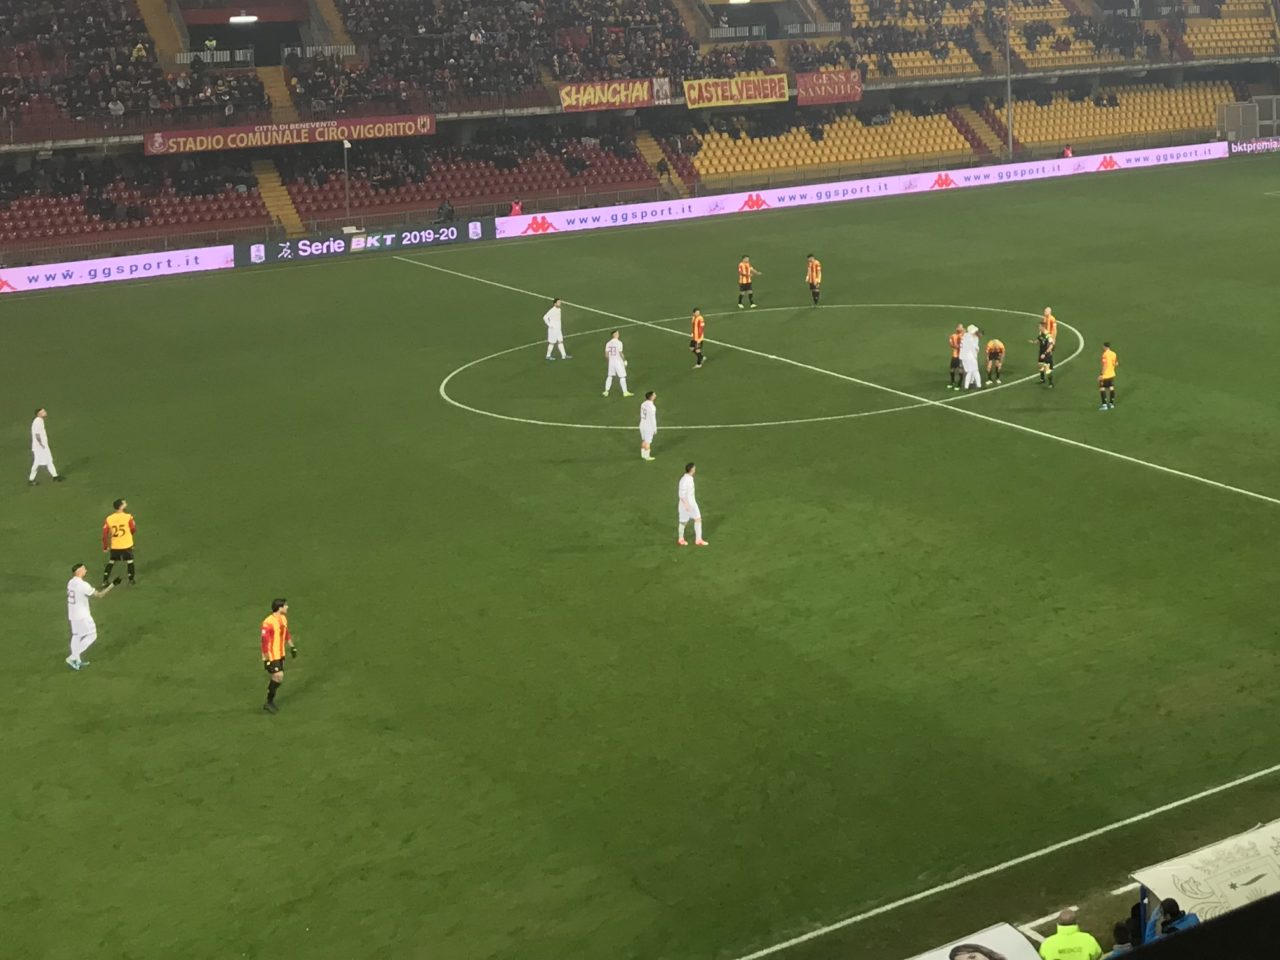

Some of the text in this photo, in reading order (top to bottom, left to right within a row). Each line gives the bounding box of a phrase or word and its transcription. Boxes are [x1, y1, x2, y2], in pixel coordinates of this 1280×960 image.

[560, 80, 650, 107] SHANGHAI
[168, 121, 416, 152] STADIO COMUNALE CIRO VIGORITO
[280, 123, 289, 131] DI
[290, 120, 338, 130] BENEVENTO
[1125, 147, 1212, 164] www.ggsport.it
[964, 162, 1061, 183] www.ggsport.it
[777, 182, 888, 203] www.ggsport.it
[566, 203, 693, 226] www.ggsport.it
[298, 226, 457, 257] Serie BKT 2019-20
[27, 253, 200, 284] www.ggsport.it
[111, 524, 126, 538] 25
